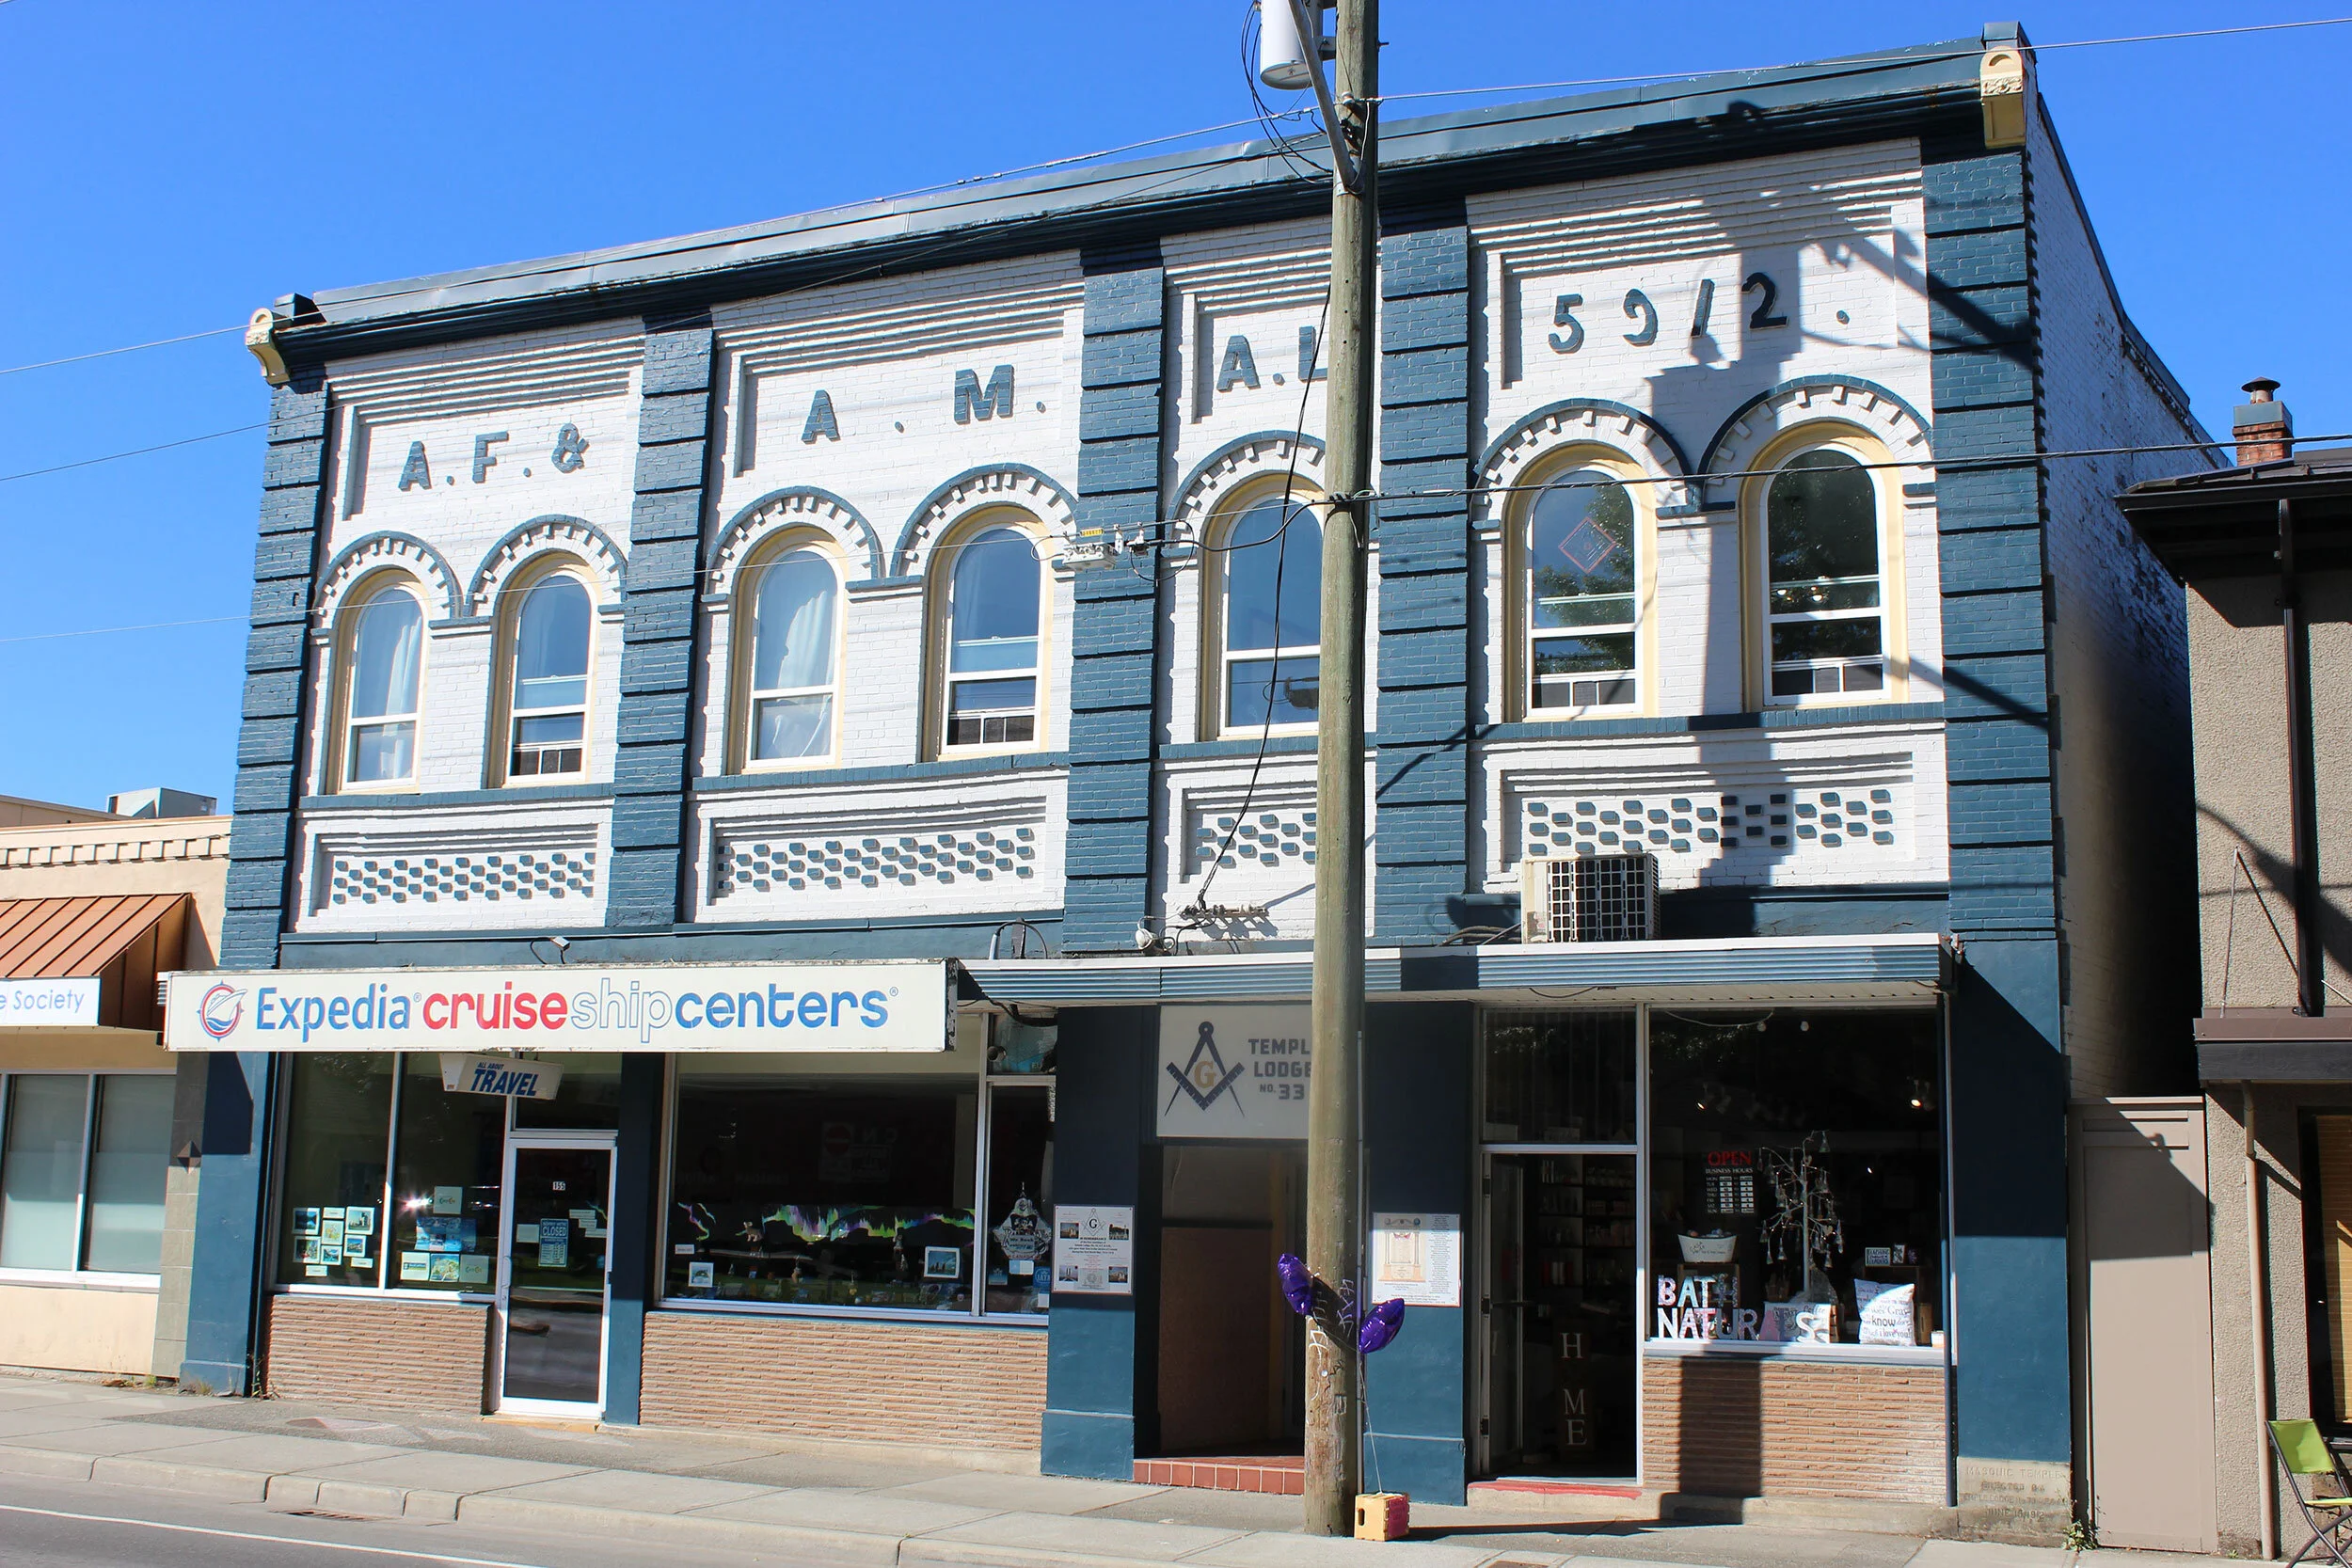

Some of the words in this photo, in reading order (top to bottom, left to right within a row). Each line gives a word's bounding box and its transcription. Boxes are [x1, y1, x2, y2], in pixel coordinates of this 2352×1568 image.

[13, 990, 85, 1013] Society
[1248, 1038, 1311, 1055] TEMPL
[470, 1069, 539, 1096] TRAVEL
[1193, 1060, 1217, 1089] G
[1259, 1084, 1277, 1094] NO.
[1279, 1084, 1305, 1101] 33
[1707, 1150, 1753, 1167] OPEN
[542, 1226, 567, 1237] CLOSED
[1658, 1273, 1739, 1308] BATH
[1657, 1307, 1819, 1343] NATURALS
[1871, 1316, 1896, 1327] know
[1561, 1332, 1588, 1446] HME
[1965, 1466, 2014, 1477] MASONIC
[2020, 1468, 2061, 1480] TEMPLE
